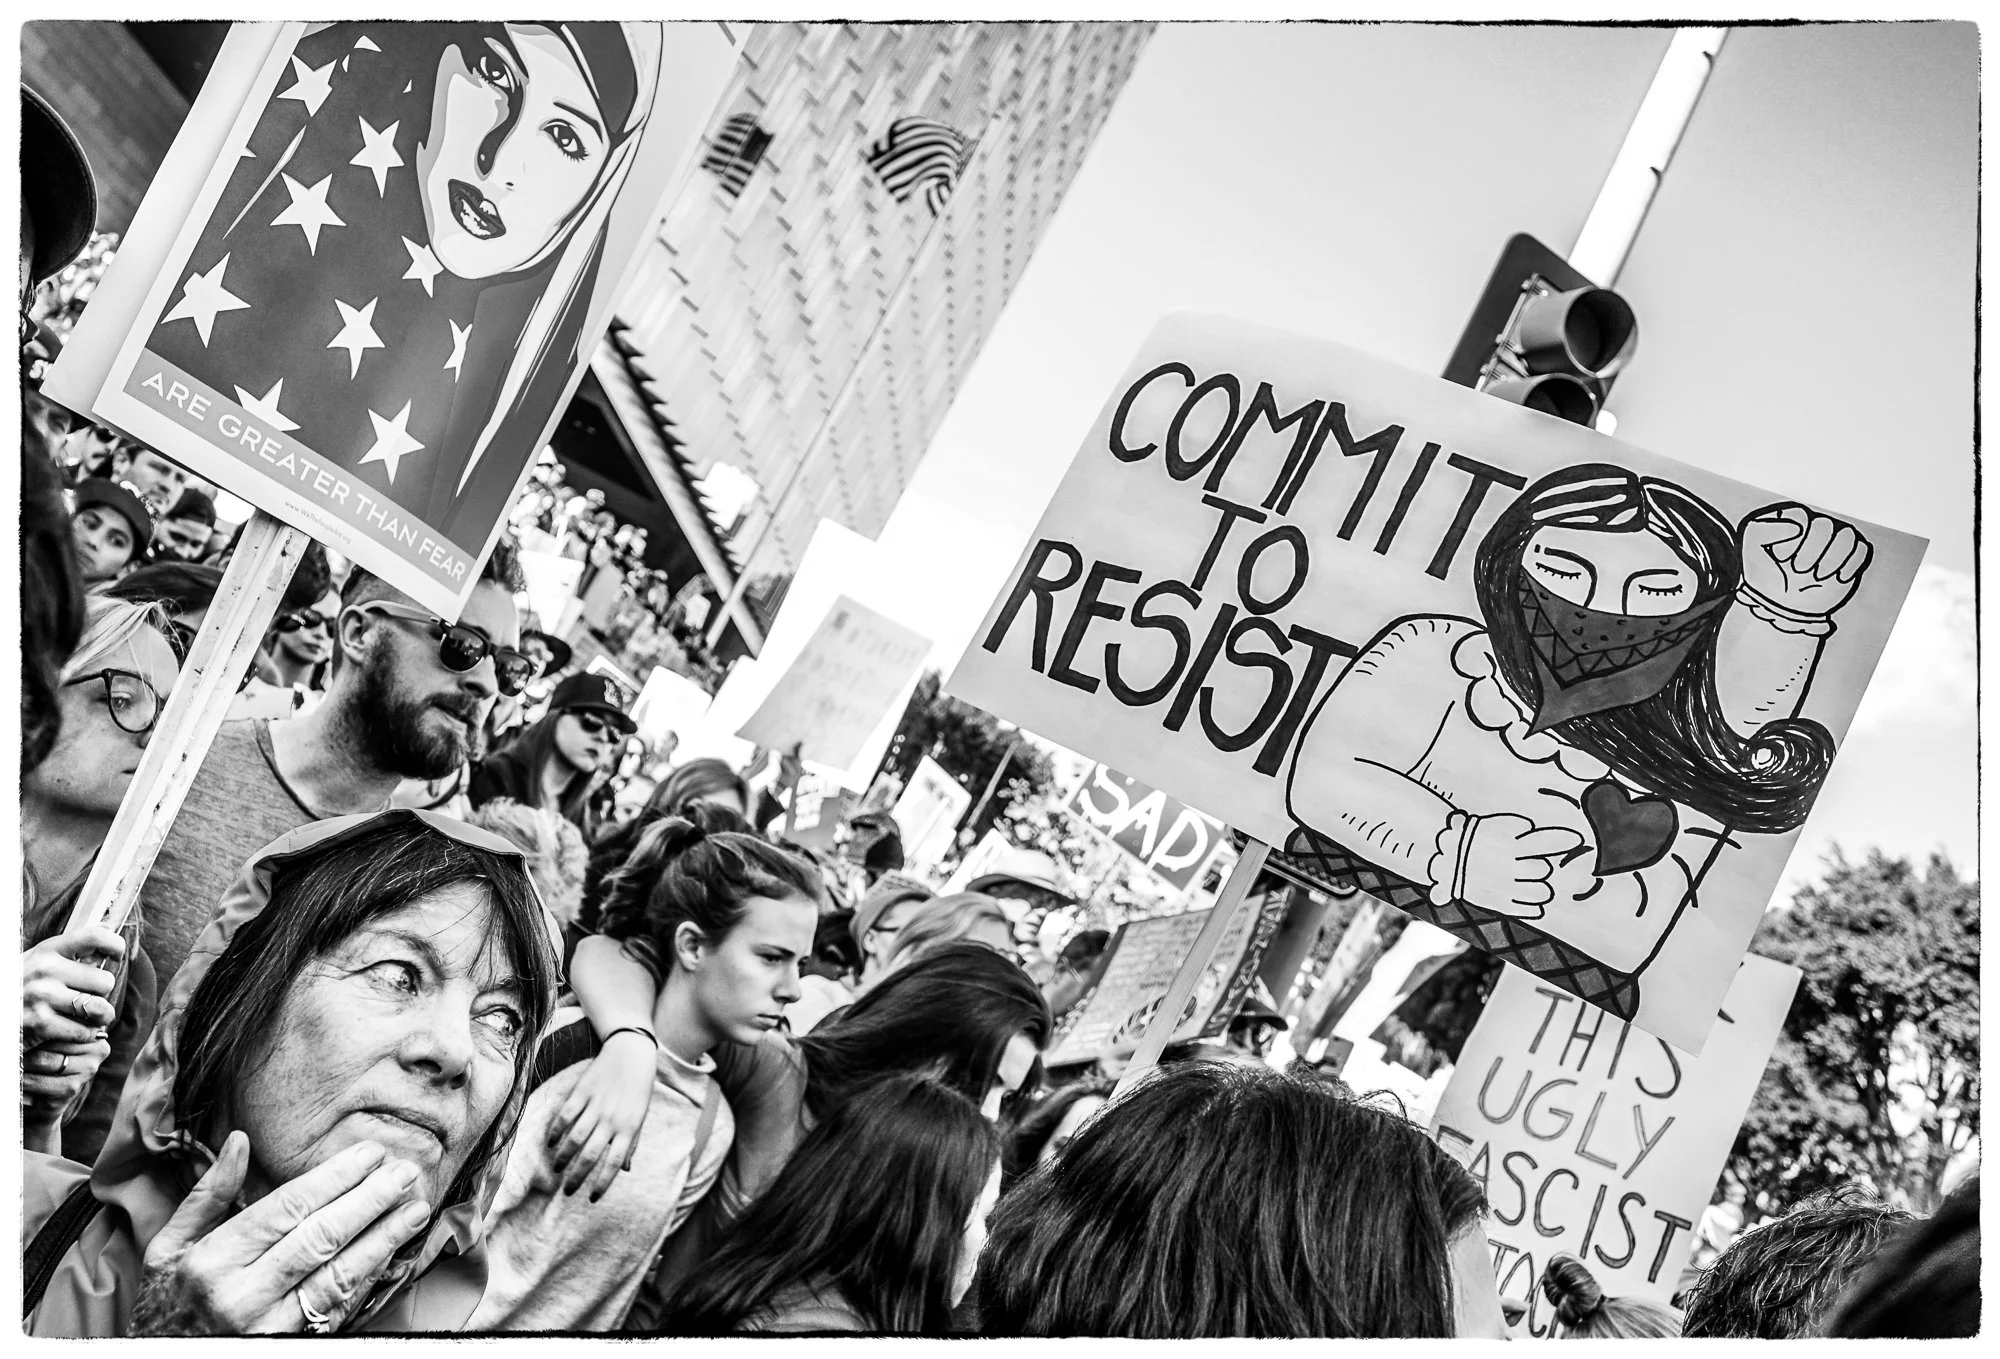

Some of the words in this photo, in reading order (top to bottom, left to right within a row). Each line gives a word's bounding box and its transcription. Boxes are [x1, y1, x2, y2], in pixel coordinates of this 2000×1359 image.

[141, 371, 213, 422] ARE
[217, 413, 350, 506] GREATER
[356, 491, 419, 549] THAN
[418, 538, 467, 582] FEAR
[1109, 362, 1528, 580] COMMIT
[1190, 493, 1310, 616] TO
[982, 538, 1360, 778] RESIST
[1076, 762, 1209, 873] SAD
[1528, 986, 1682, 1099] THIS
[1477, 1056, 1676, 1180] UGLY
